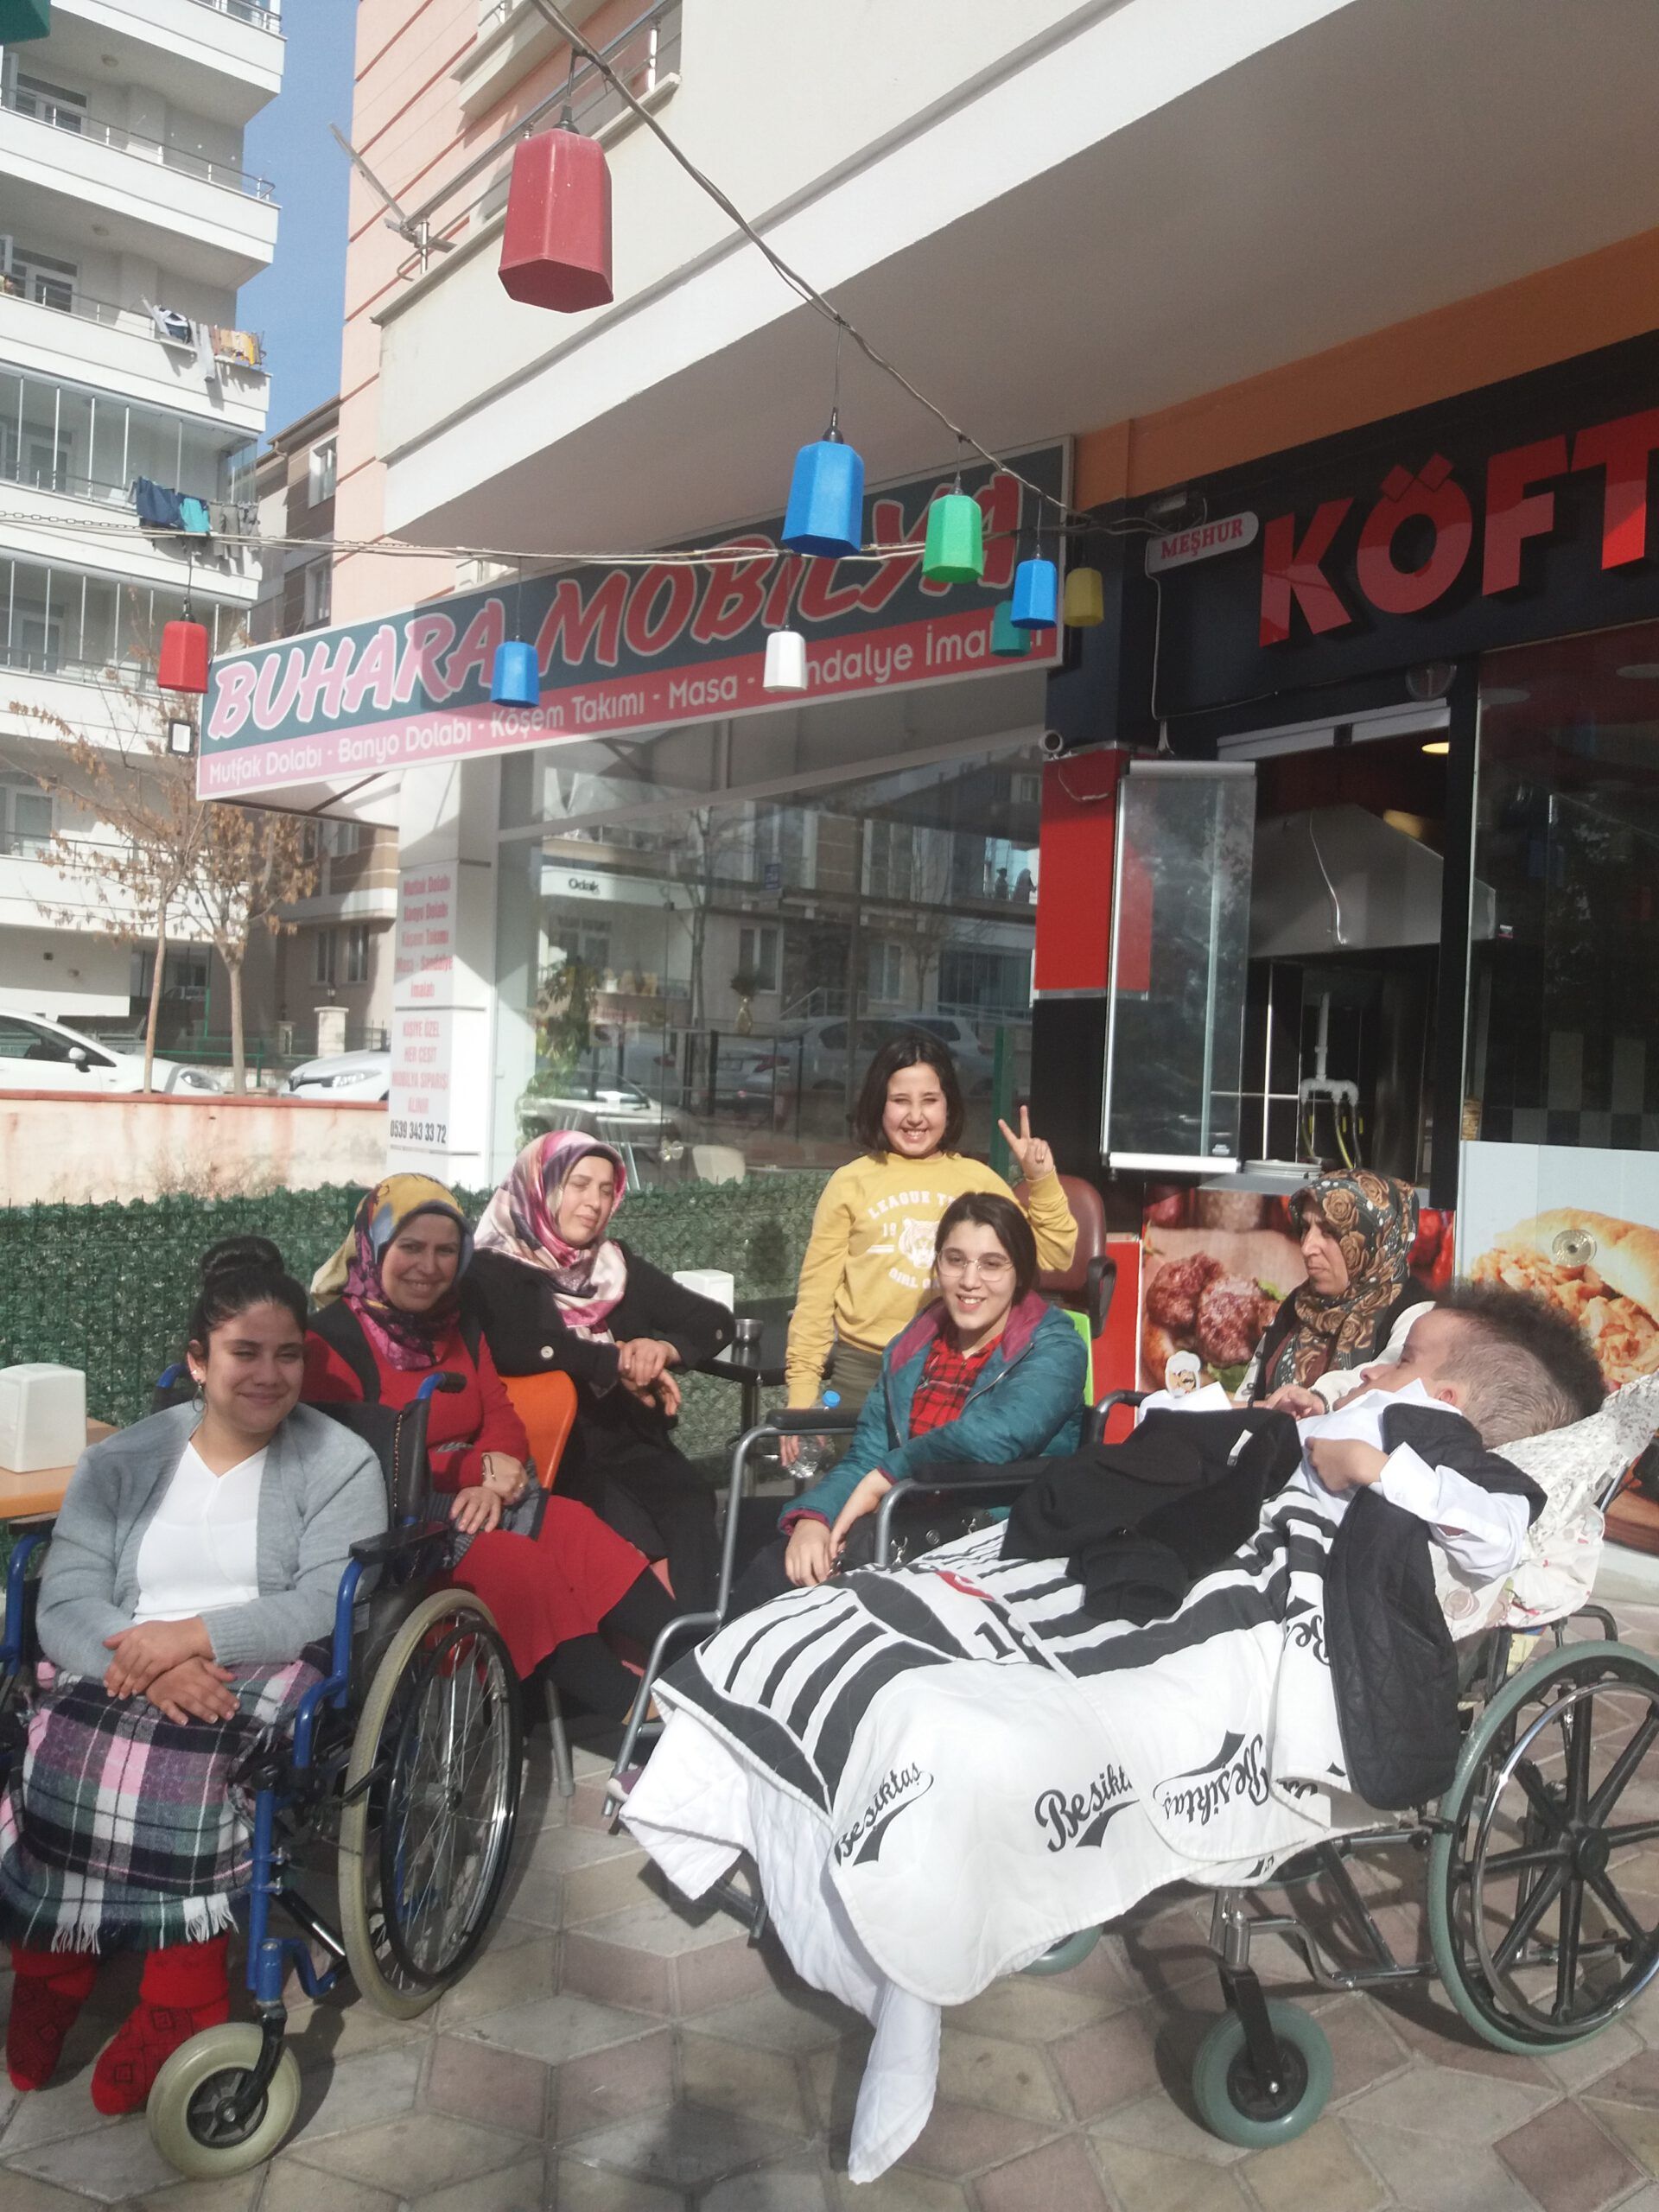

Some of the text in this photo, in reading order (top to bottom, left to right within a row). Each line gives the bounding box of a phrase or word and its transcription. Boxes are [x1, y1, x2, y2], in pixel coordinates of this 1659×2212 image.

[1160, 518, 1243, 560] MEŞHUR
[207, 598, 505, 741] BUHARA
[209, 755, 261, 785] Mutfak
[266, 745, 321, 775] Dolabı
[338, 734, 399, 764] Banyo
[405, 718, 472, 752] Dolabı
[490, 704, 564, 740] Köşem
[571, 690, 645, 724] Takımı
[668, 675, 738, 709] Masa
[805, 642, 913, 684] ndalye
[409, 1121, 423, 1141] 343
[424, 1122, 435, 1142] 33
[436, 1123, 447, 1144] 72
[868, 1191, 931, 1219] LEAGUE
[1034, 1764, 1133, 1853] Beşikt
